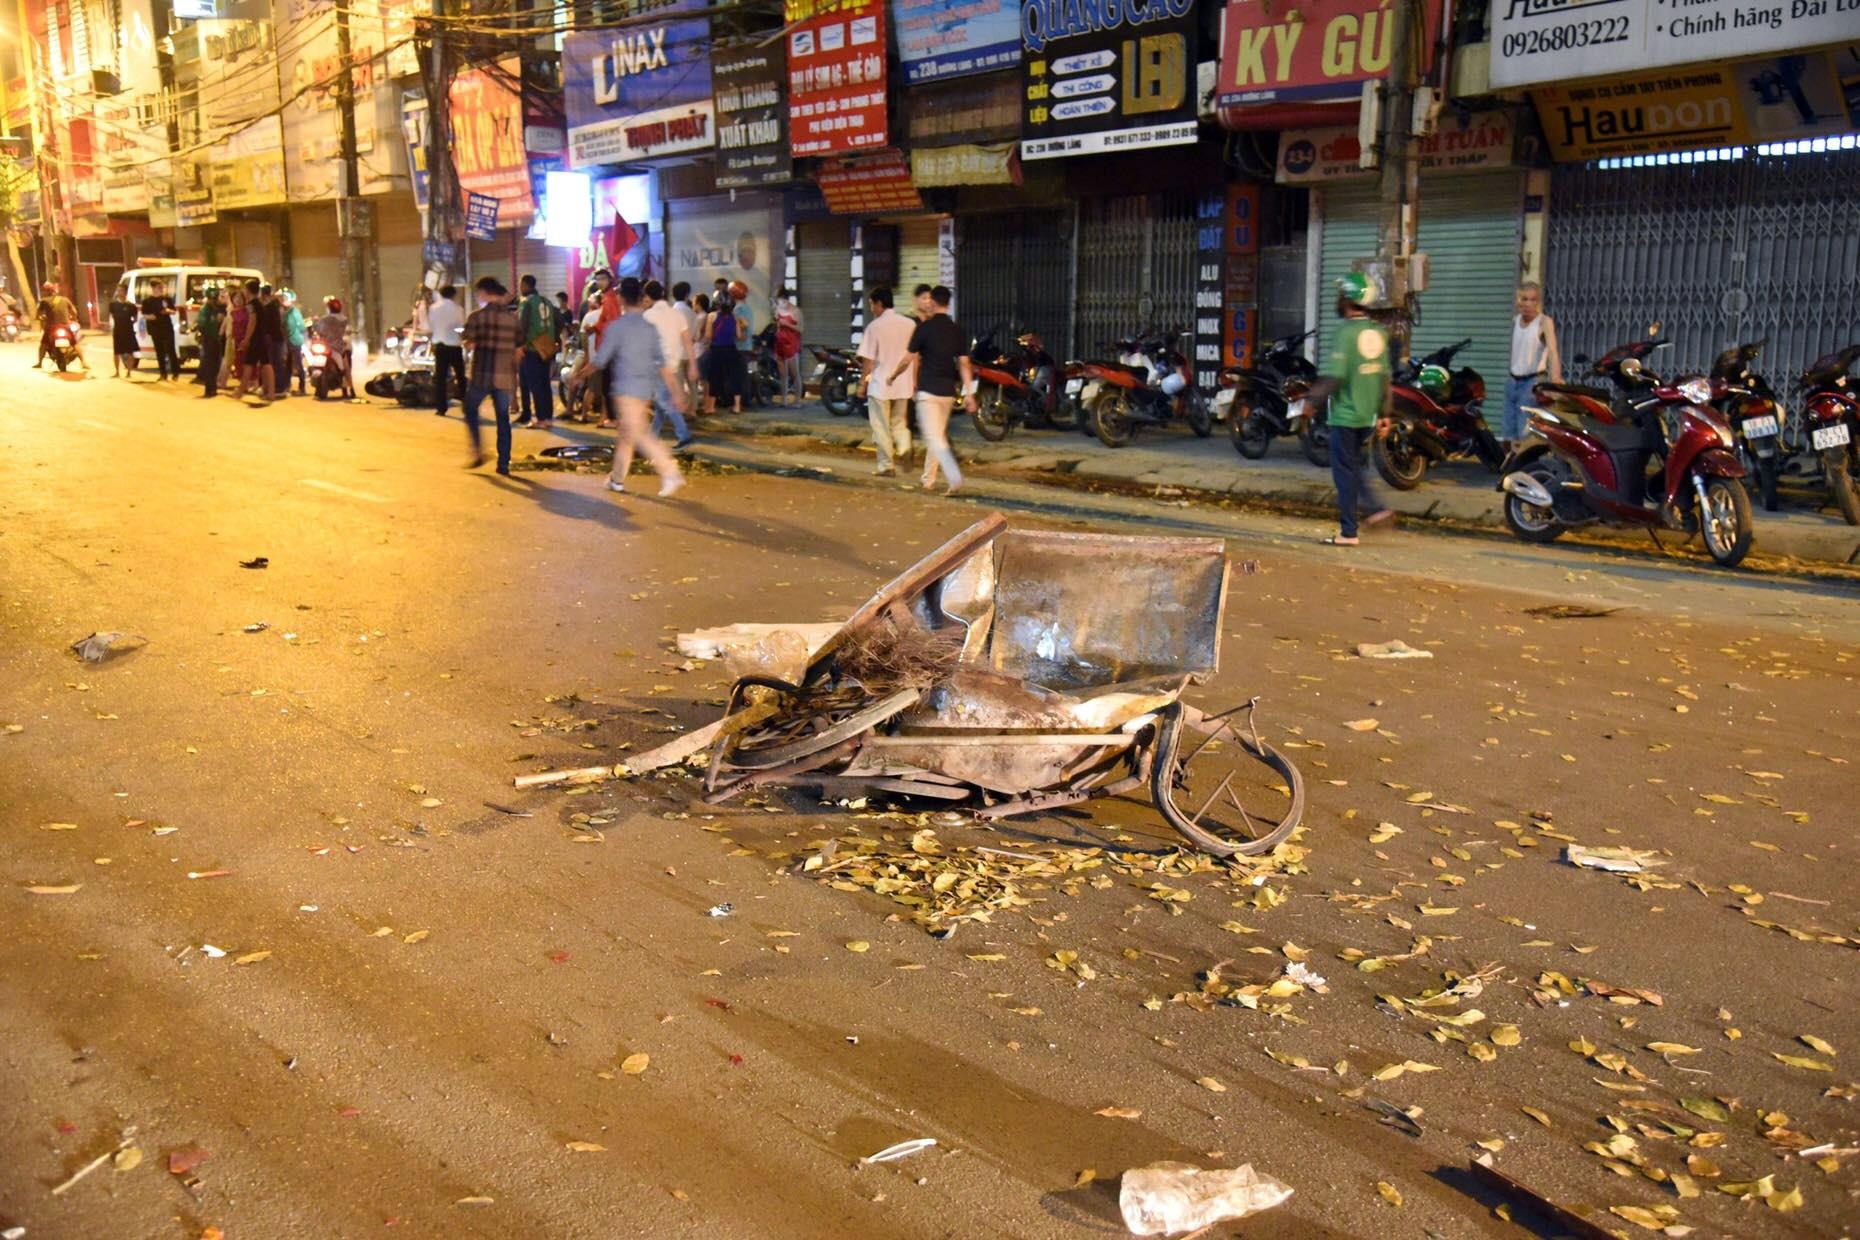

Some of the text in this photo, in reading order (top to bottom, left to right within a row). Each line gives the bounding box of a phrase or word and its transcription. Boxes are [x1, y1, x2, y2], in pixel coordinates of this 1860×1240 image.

[1502, 16, 1629, 57] 0926803222
[1669, 12, 1726, 37] Chính
[1734, 7, 1783, 29] hãng
[612, 27, 668, 78] INAX
[1121, 32, 1187, 116] LED
[741, 81, 779, 108] TRANG
[1200, 264, 1219, 281] ALU
